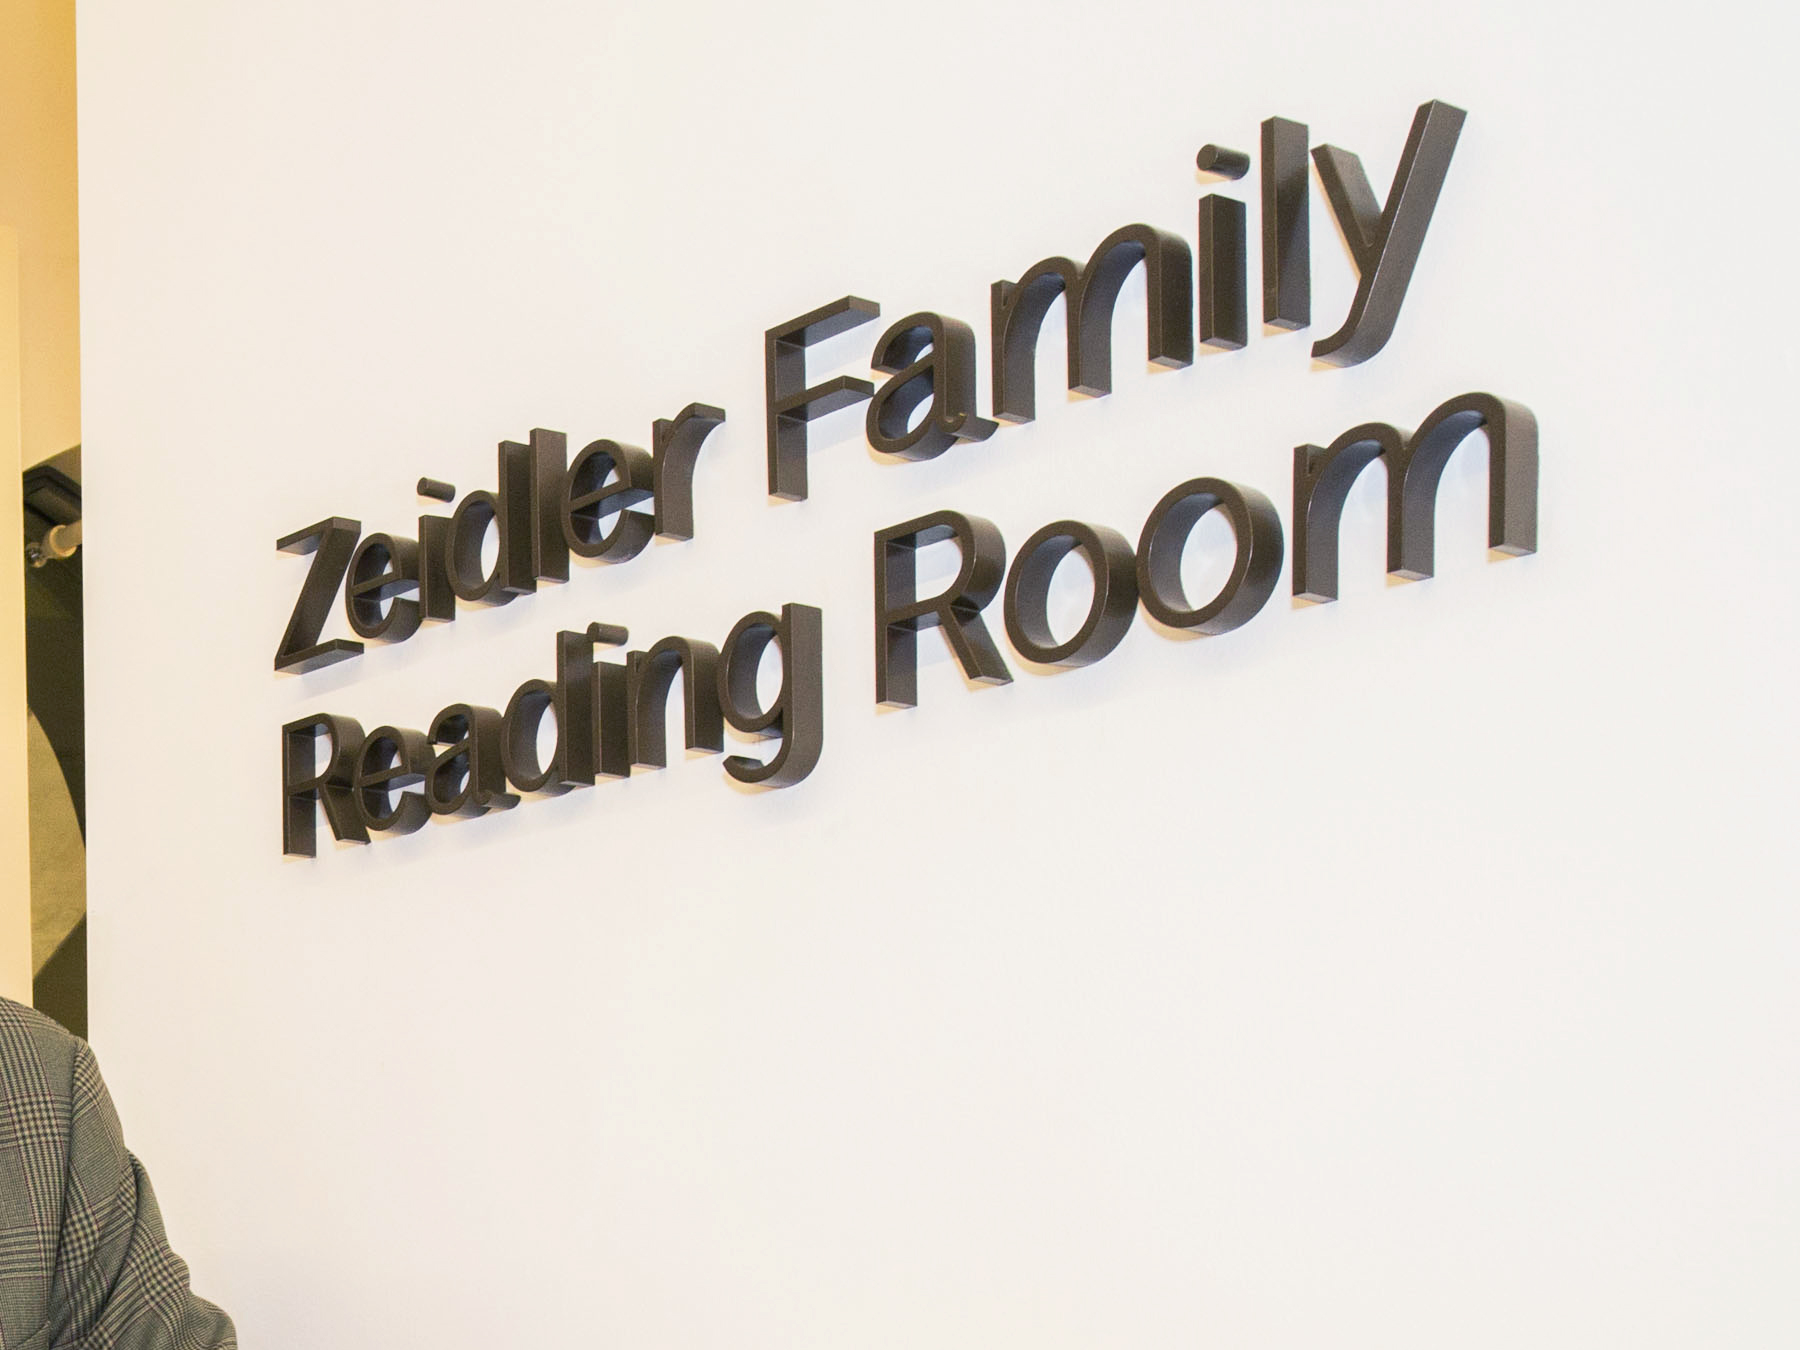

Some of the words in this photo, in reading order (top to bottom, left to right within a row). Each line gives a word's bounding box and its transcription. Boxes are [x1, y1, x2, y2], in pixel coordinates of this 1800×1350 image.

[275, 403, 726, 674] Zeidler
[764, 99, 1468, 501] Family
[282, 603, 823, 859] Reading
[874, 392, 1539, 707] Room
